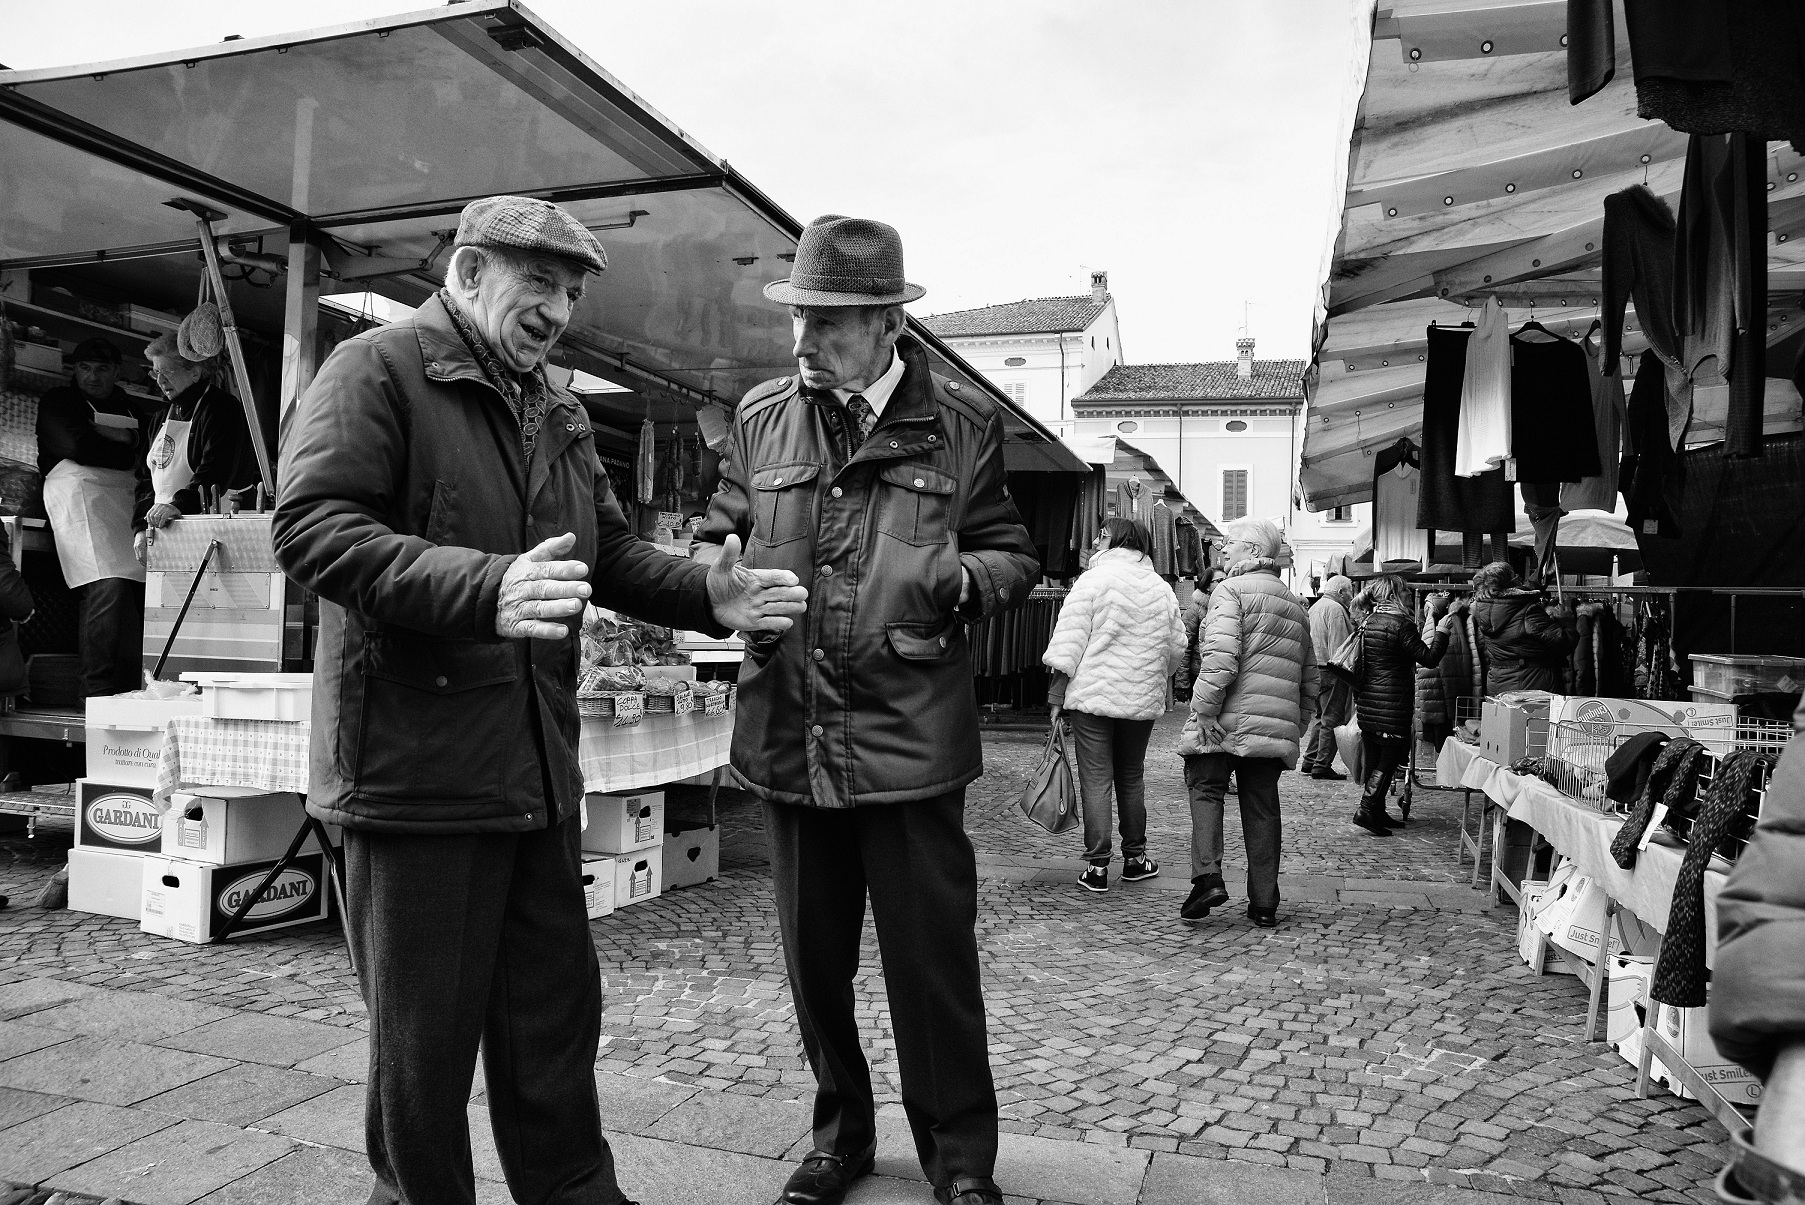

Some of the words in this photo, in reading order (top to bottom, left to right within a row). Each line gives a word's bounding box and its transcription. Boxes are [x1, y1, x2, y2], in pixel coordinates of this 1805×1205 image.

[611, 458, 630, 469] PADANO
[620, 703, 641, 712] DOLCE
[1577, 705, 1608, 722] Chiquita
[1715, 716, 1731, 726] Just
[103, 744, 133, 758] Prodotto
[134, 747, 142, 758] di
[115, 759, 133, 767] trattare
[93, 807, 160, 830] GARDANI
[1571, 930, 1588, 941] Just
